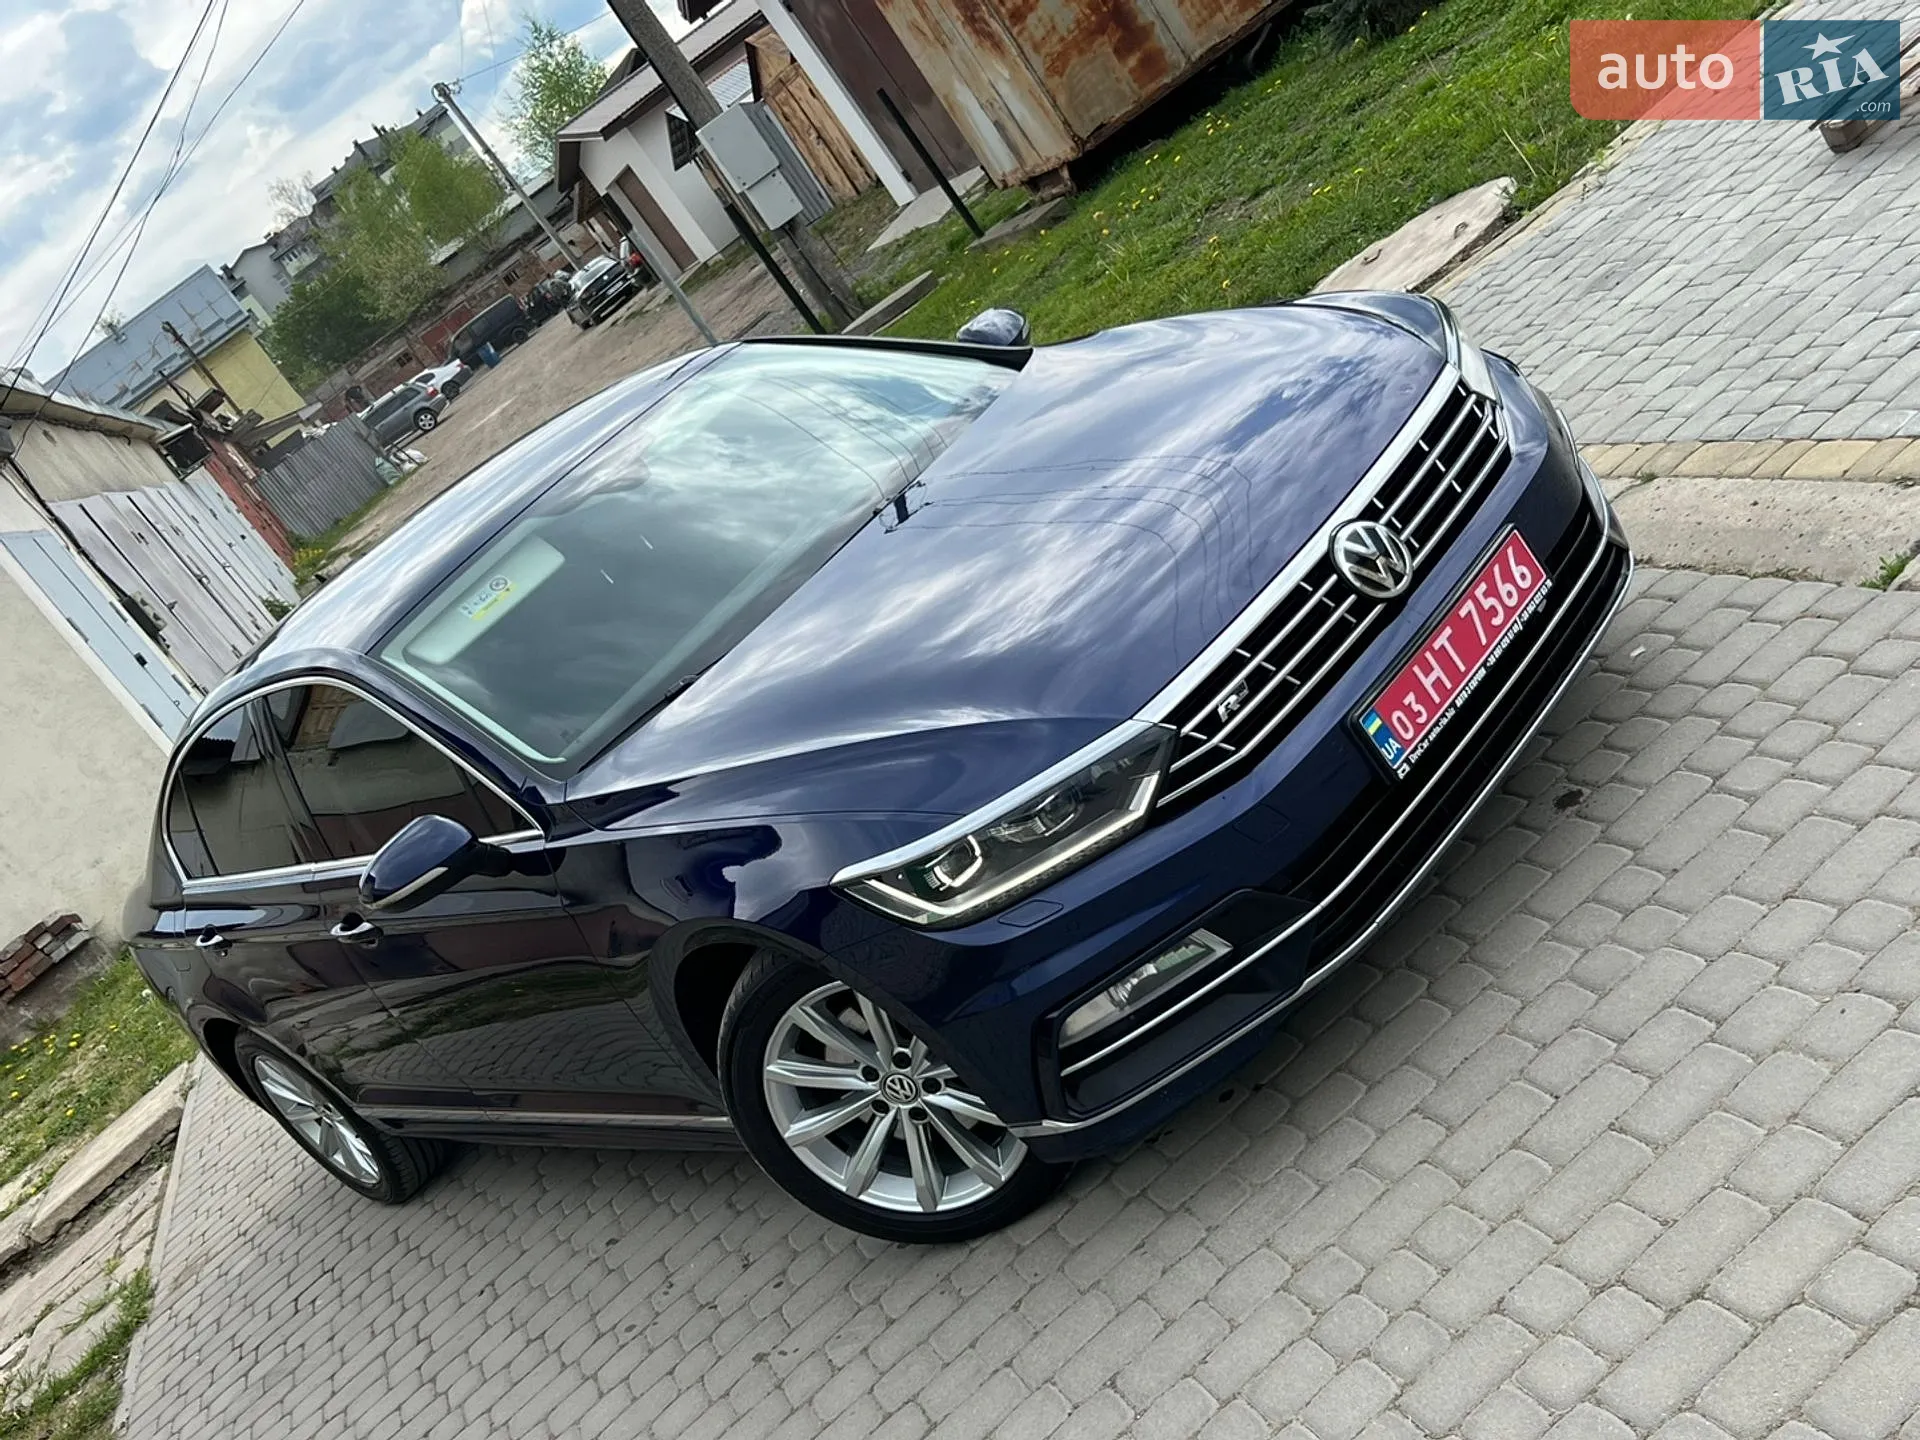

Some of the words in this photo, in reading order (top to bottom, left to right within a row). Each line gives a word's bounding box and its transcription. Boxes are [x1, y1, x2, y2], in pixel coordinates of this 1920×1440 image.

[1391, 691, 1428, 742] 03
[1412, 626, 1467, 704] HT
[1458, 546, 1532, 646] 7566
[1381, 742, 1402, 760] UA
